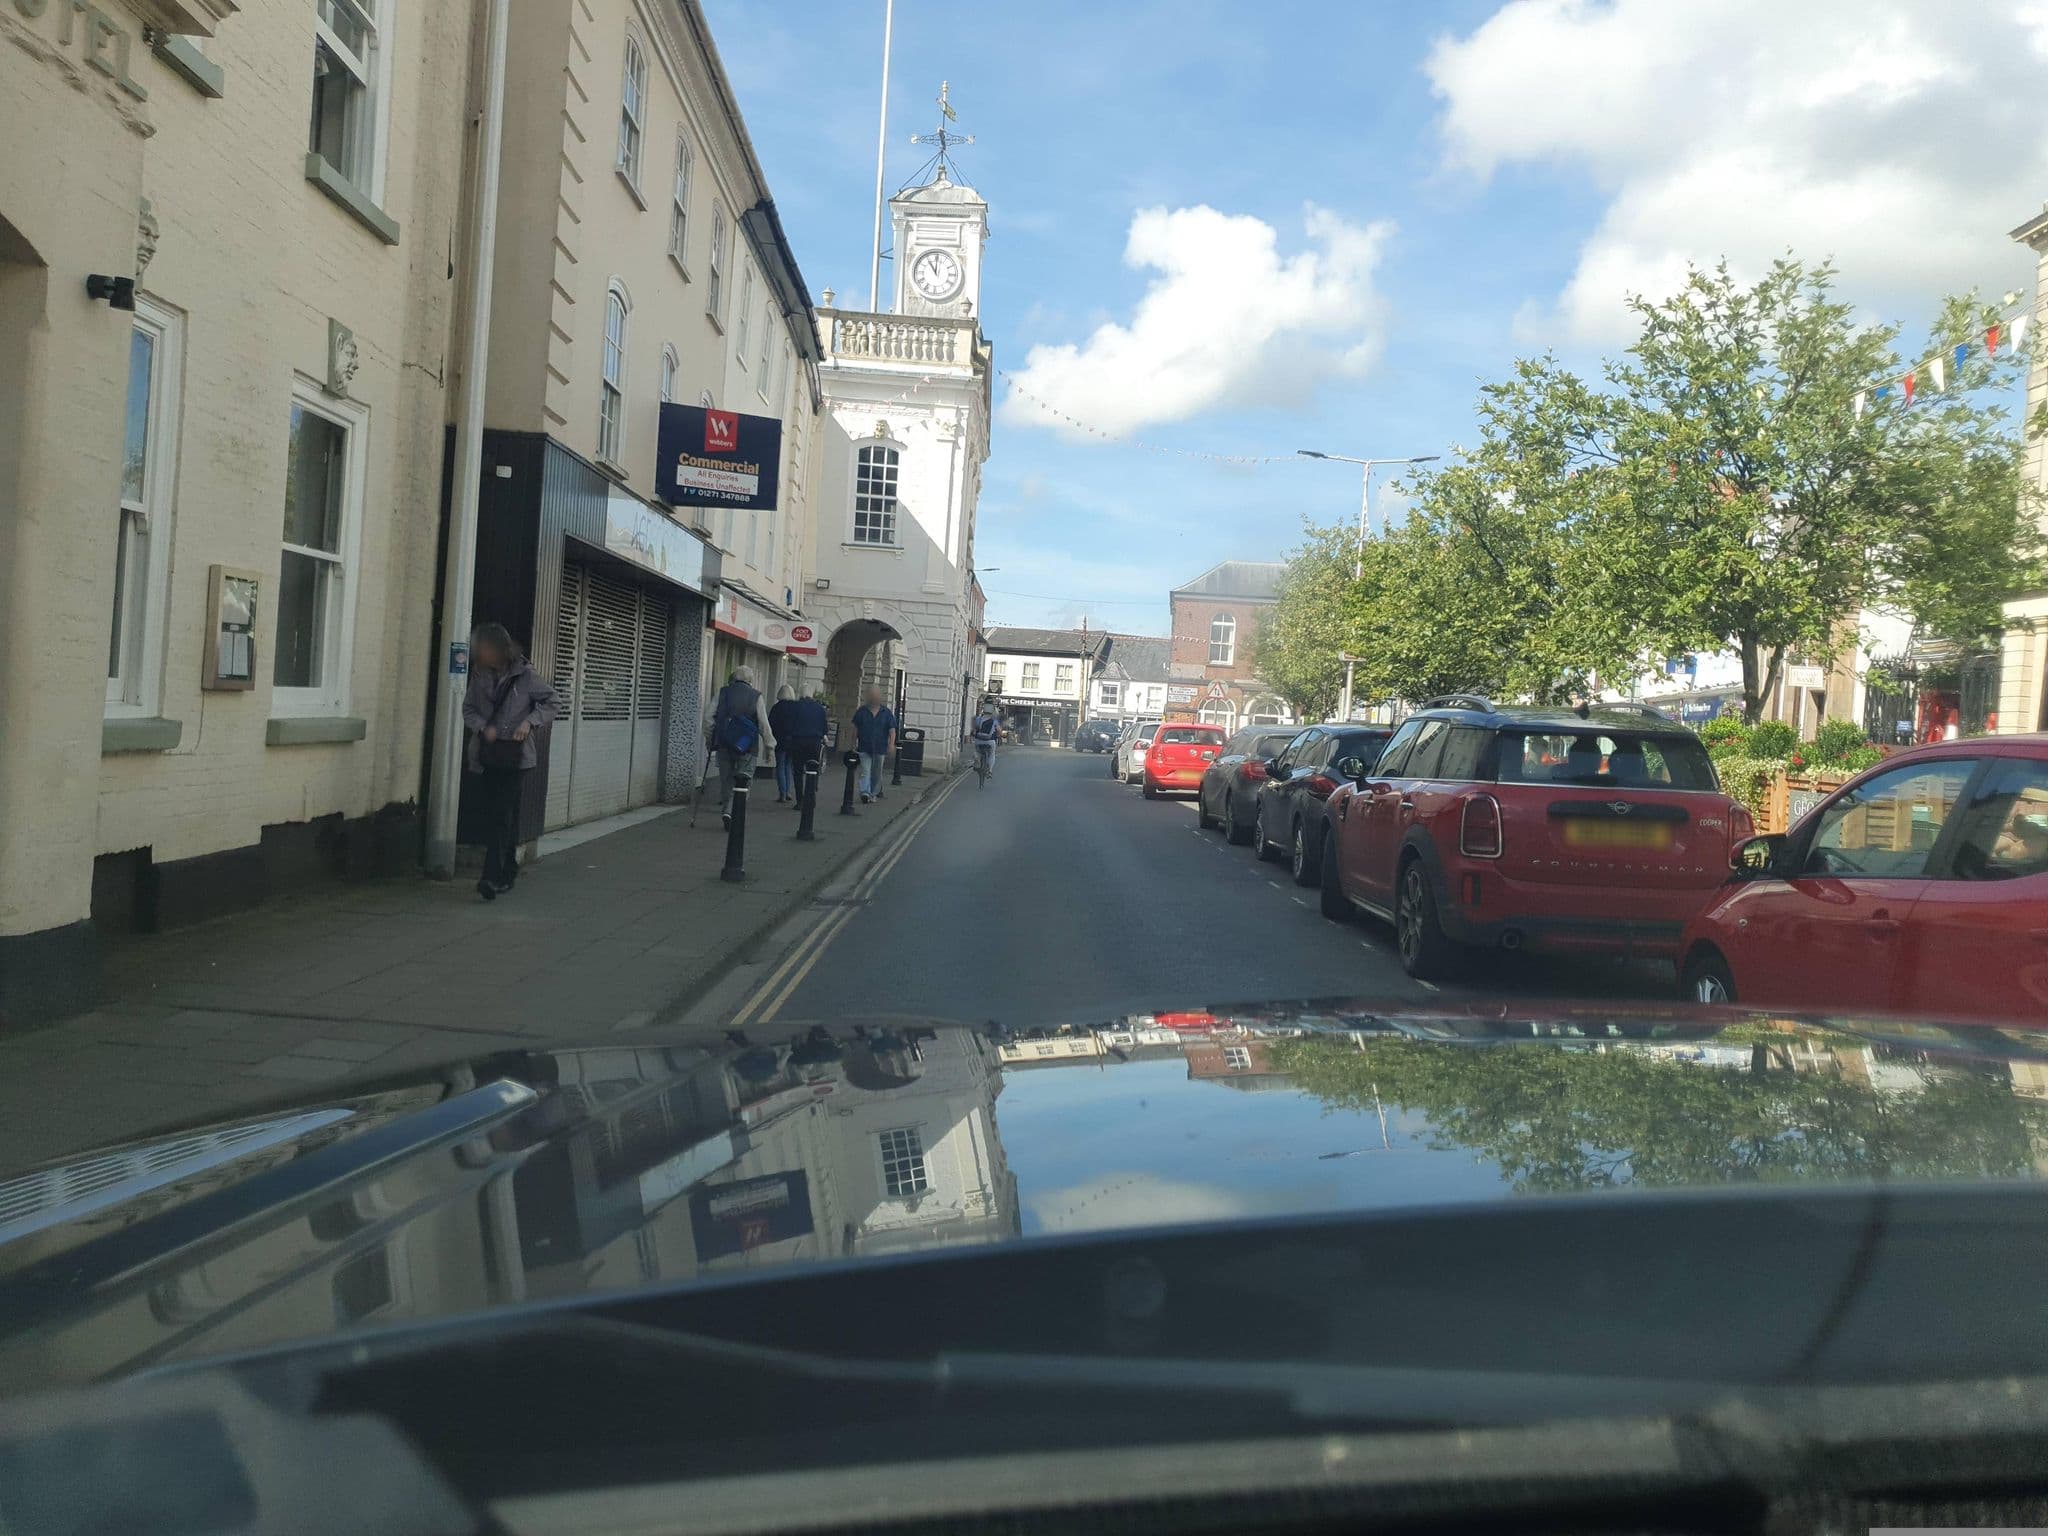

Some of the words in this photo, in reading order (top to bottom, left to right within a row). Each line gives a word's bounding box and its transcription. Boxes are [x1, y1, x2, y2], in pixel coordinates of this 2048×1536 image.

[679, 453, 759, 474] Commercial
[708, 471, 739, 482] Enquiries
[684, 478, 714, 489] Business
[716, 482, 751, 494] Unaffected
[698, 490, 719, 498] 01271
[721, 493, 751, 502] 347888
[1010, 698, 1035, 706] CHEESE
